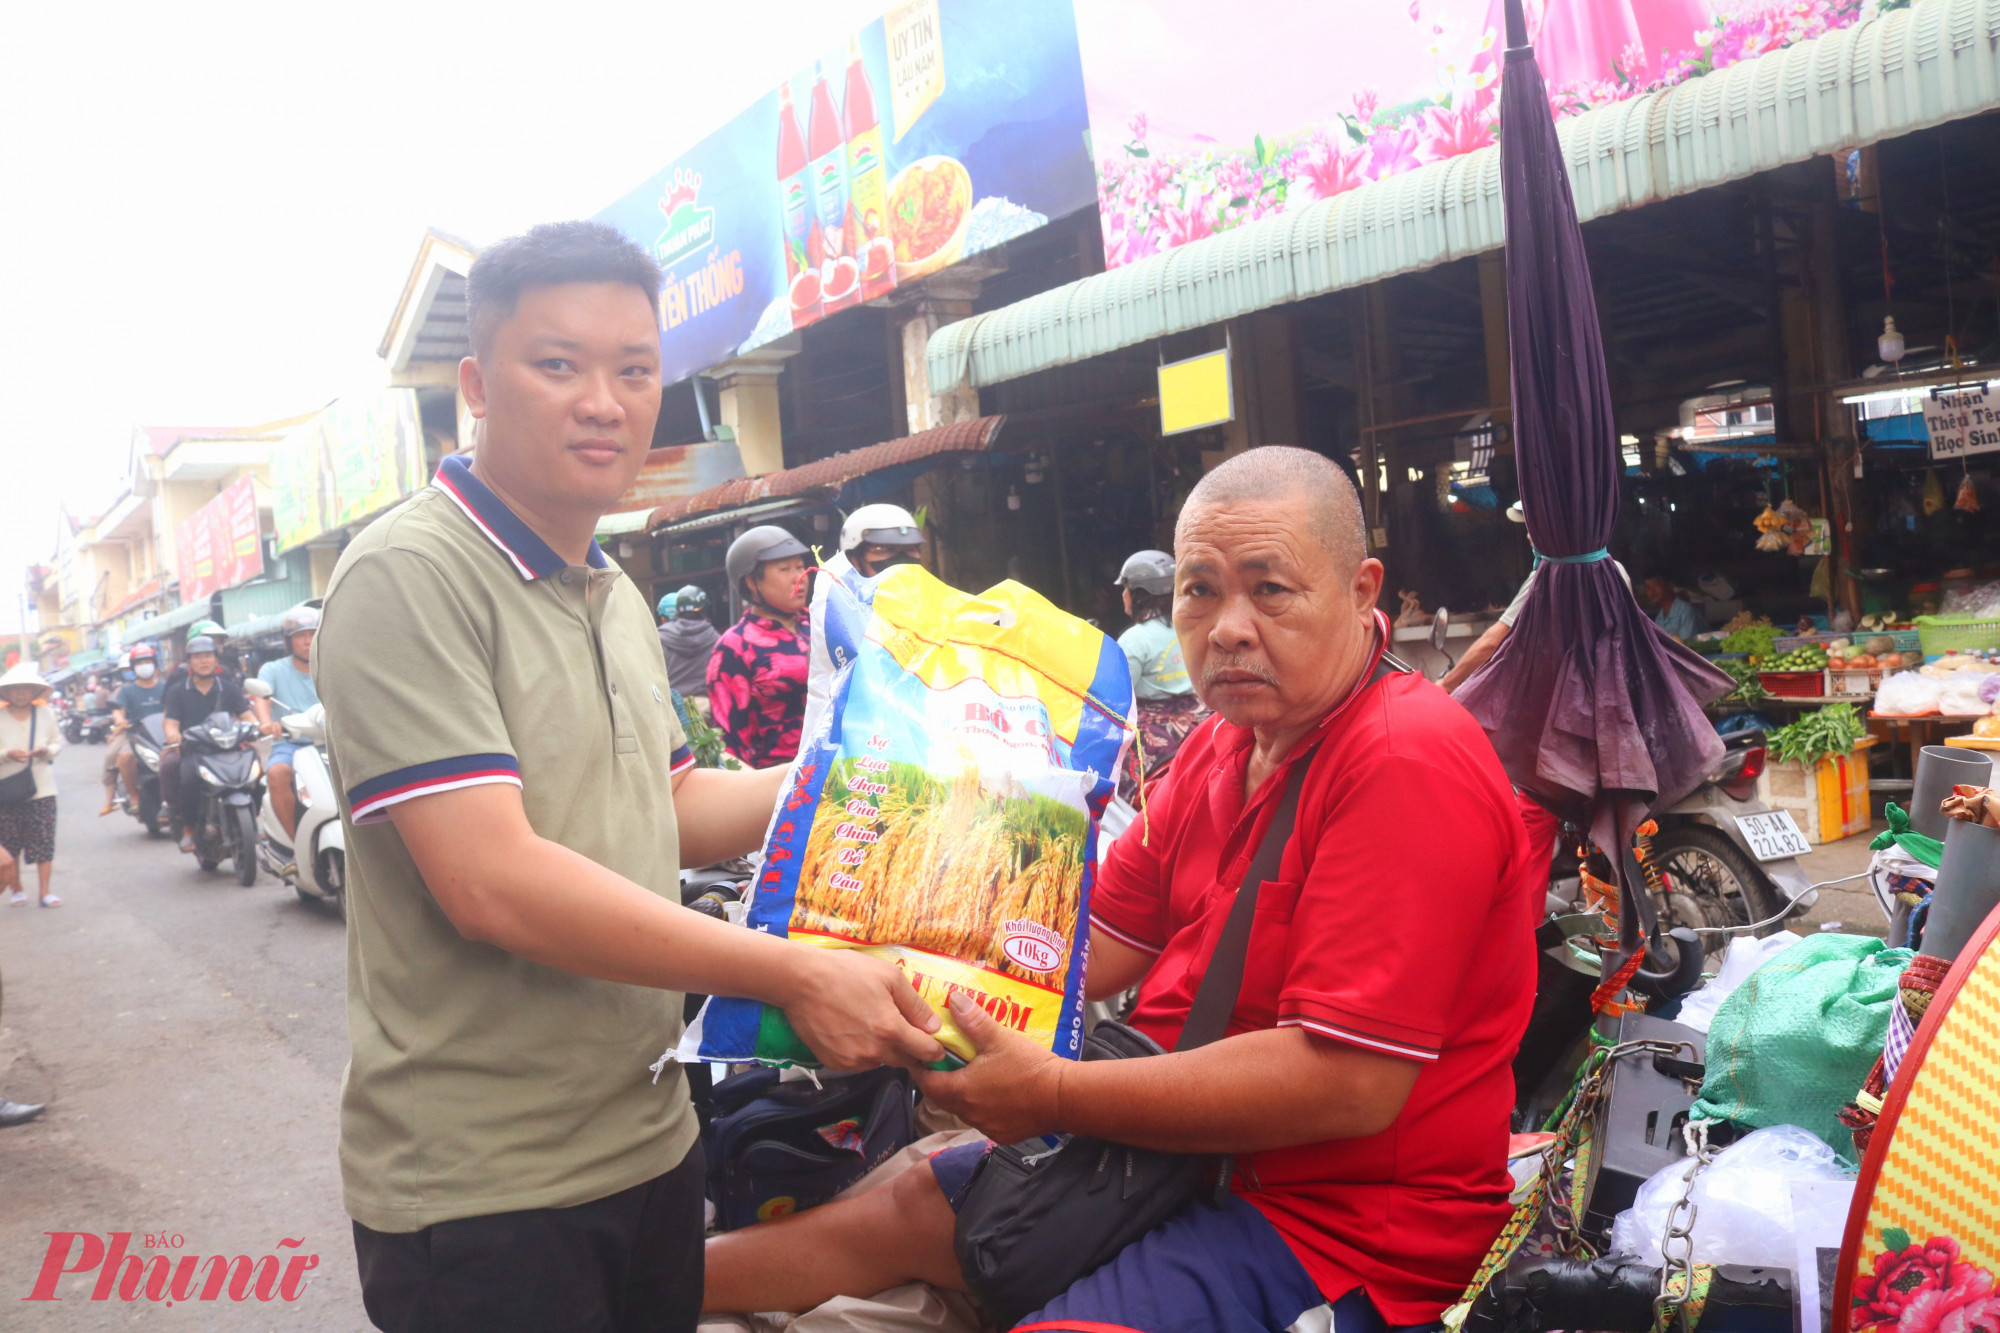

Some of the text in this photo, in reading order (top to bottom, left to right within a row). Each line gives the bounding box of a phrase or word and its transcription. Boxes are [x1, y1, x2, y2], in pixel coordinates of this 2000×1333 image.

[892, 28, 909, 62] UY
[686, 244, 744, 317] THỐNG
[1940, 393, 1983, 410] Nhận
[1969, 428, 2000, 446] Sin
[867, 734, 890, 751] Sự
[855, 755, 889, 773] Lựa
[847, 776, 887, 796] Chọn
[846, 800, 877, 817] Của
[836, 823, 877, 842] Chim
[1744, 814, 1789, 836] 50-AA
[1754, 833, 1805, 857] 224.82
[839, 848, 865, 865] Bồ
[829, 872, 861, 890] Câu
[1005, 919, 1026, 933] Khối
[1029, 922, 1051, 941] lượng
[1017, 940, 1049, 967] 10kg
